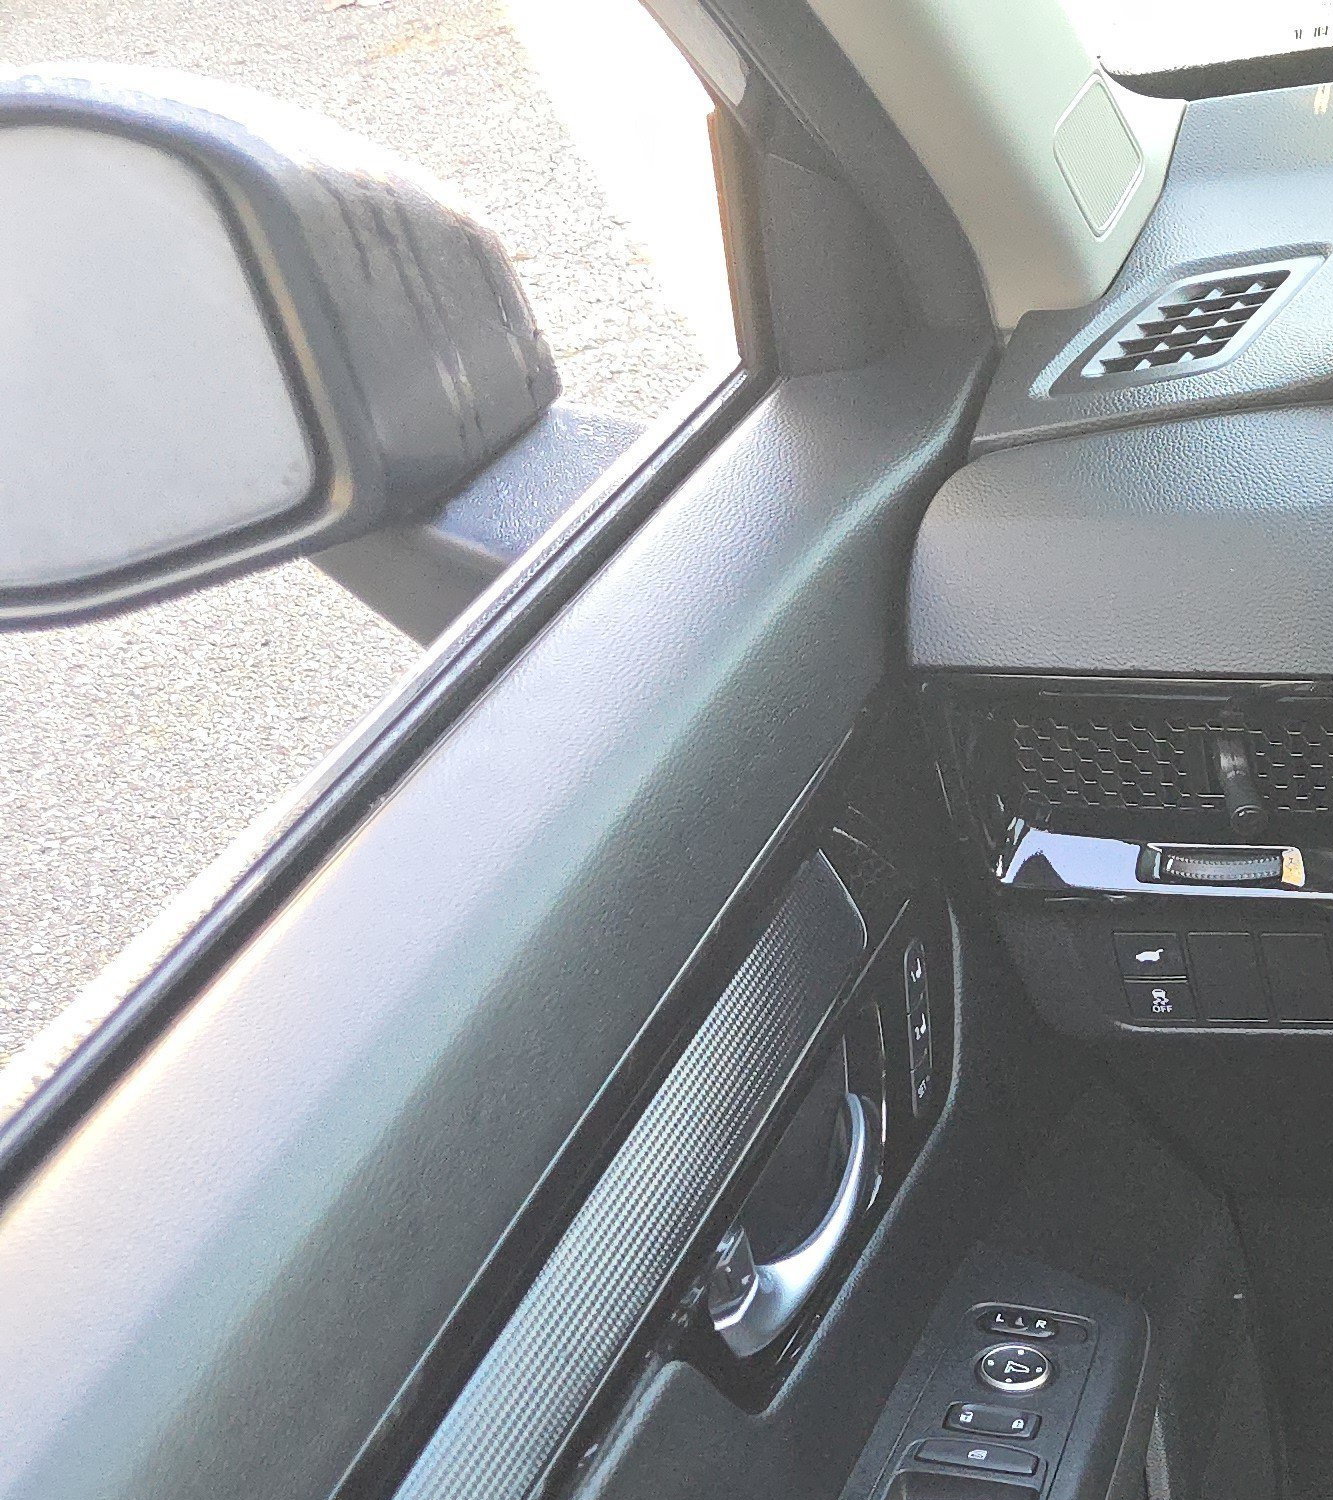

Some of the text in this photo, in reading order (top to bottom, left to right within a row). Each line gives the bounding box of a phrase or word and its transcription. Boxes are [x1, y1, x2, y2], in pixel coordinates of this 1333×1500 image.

[1152, 1004, 1172, 1013] OFF
[995, 1314, 1004, 1323] L
[1036, 1319, 1047, 1329] R
